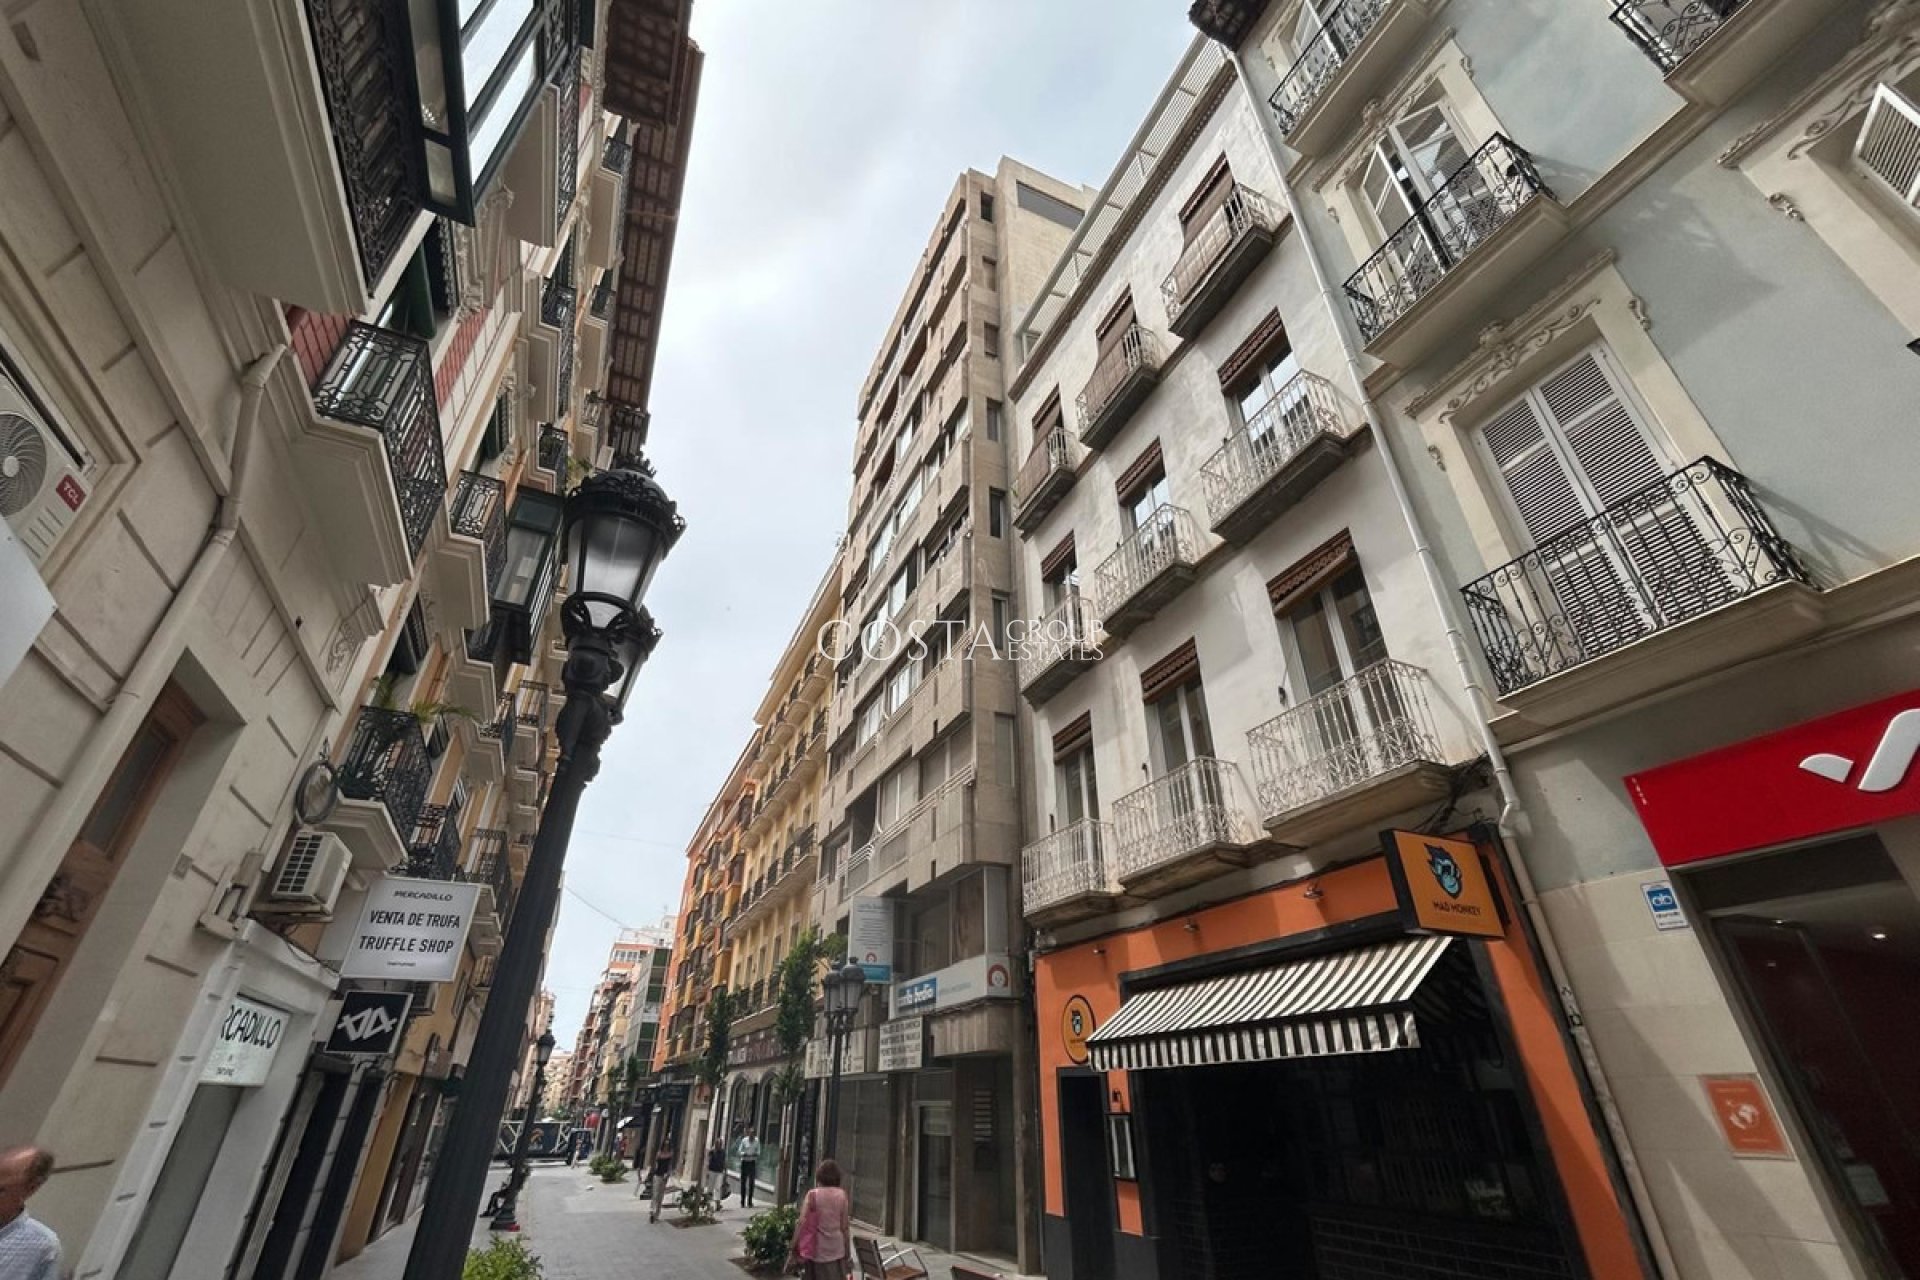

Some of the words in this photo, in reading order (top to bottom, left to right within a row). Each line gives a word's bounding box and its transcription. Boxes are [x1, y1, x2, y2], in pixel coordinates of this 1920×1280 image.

[63, 480, 80, 505] TCL
[393, 890, 453, 902] MERCADILLO
[1432, 900, 1450, 912] MAD
[1450, 903, 1481, 917] MONKEY
[370, 910, 405, 926] VENTA
[407, 912, 425, 927] DE
[426, 913, 460, 929] TRUFA
[359, 935, 417, 952] TRUFFLE
[418, 938, 454, 953] SHOP
